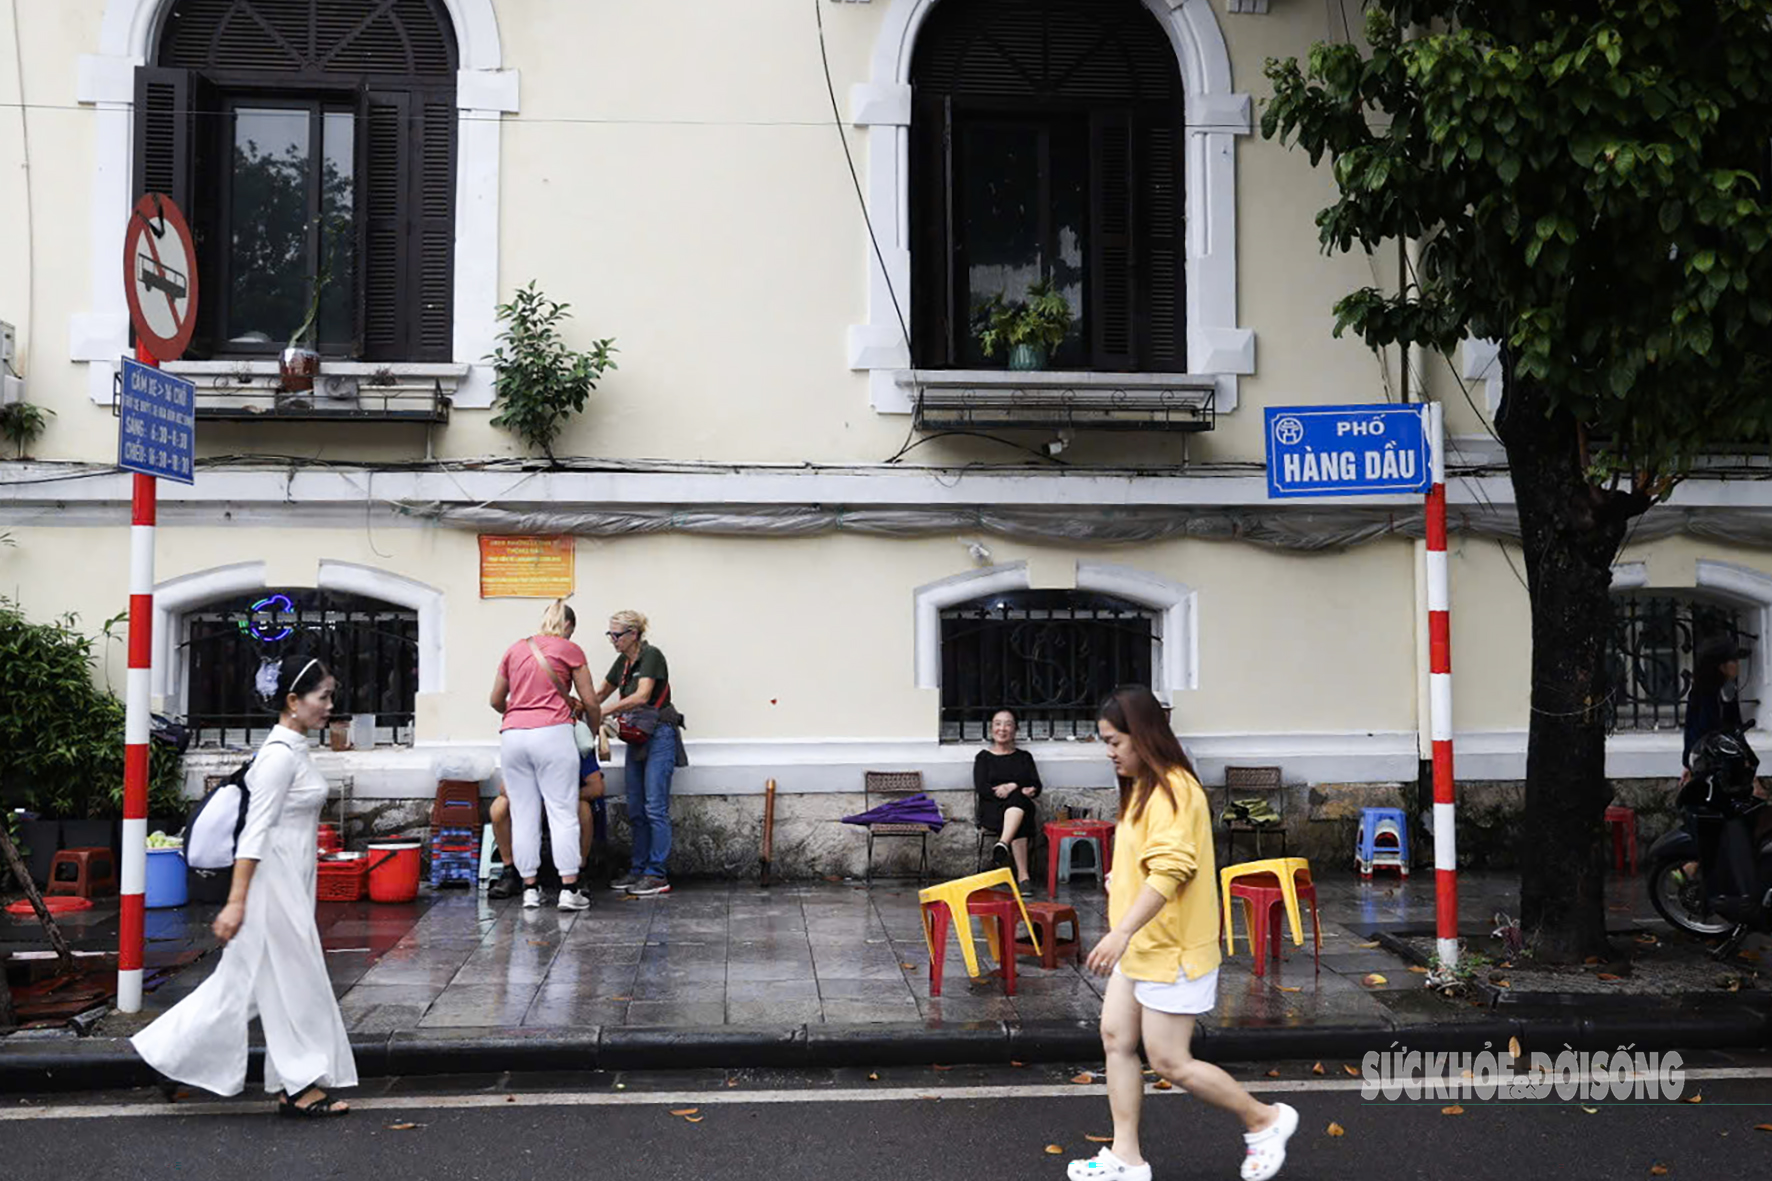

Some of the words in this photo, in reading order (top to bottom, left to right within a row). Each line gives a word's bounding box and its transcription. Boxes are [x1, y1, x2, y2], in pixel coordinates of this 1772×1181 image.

[1337, 414, 1386, 437] PHỐ
[1283, 446, 1357, 483] HÀNG
[1364, 441, 1416, 480] DẦU
